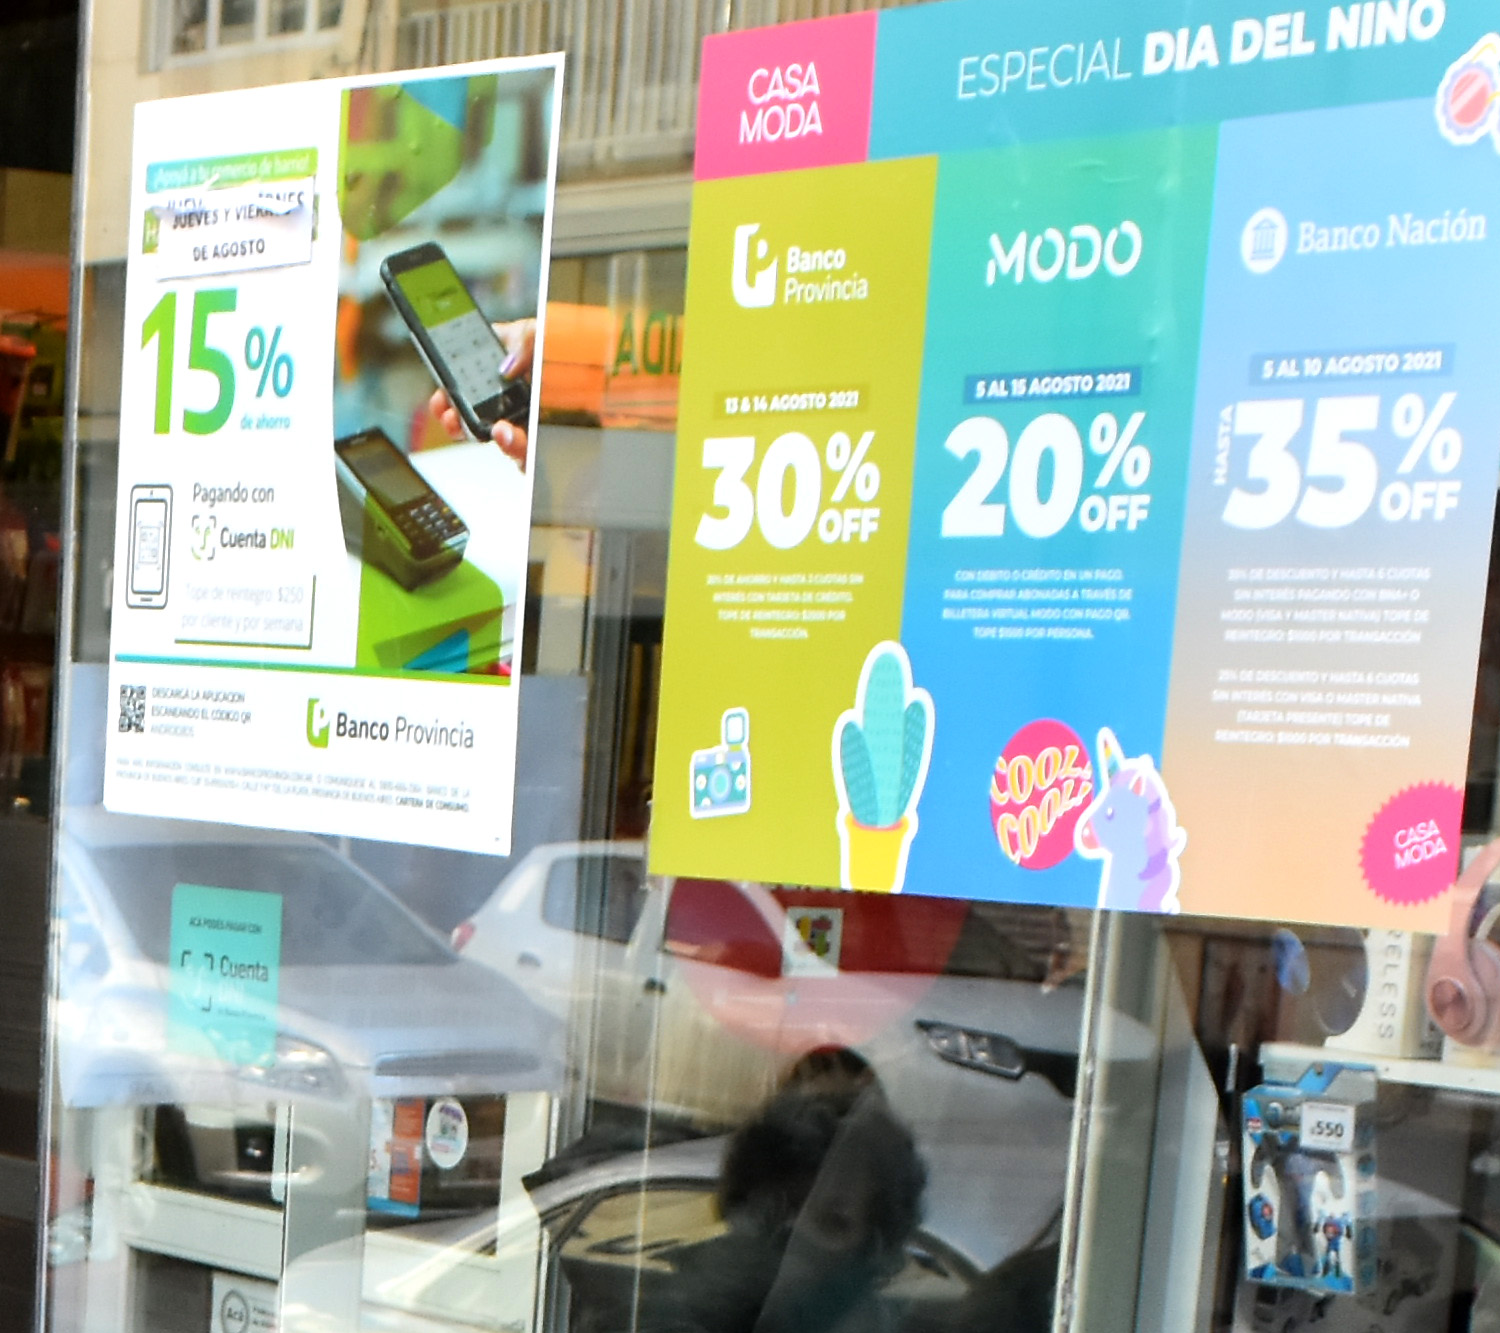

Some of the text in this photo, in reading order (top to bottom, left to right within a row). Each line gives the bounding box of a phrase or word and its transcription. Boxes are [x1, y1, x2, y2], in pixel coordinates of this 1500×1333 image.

[957, 38, 1131, 100] ESPECIAL
[1142, 24, 1219, 76] DIA
[1228, 13, 1316, 65] DEL
[749, 61, 819, 105] CASA
[739, 102, 822, 145] MODA
[223, 206, 231, 222] Y
[1298, 208, 1487, 255] Banco Nación
[193, 238, 265, 262] DE AGOSTO
[786, 247, 846, 273] Banco
[986, 221, 1142, 287] MODO
[784, 273, 868, 304] Provincia
[141, 287, 294, 435] 15%
[1262, 350, 1443, 379] 5 AL 10 AGOSTO 2021
[769, 392, 826, 411] AGOSTO
[829, 390, 859, 409] 2021
[975, 372, 1131, 399] 5 AL 15 AGOSTO 2021
[256, 413, 291, 430] ahorro
[1213, 405, 1235, 487] HASTA
[1221, 391, 1463, 530] 35%
[695, 430, 881, 550] 30%
[941, 410, 1152, 539] 20%
[193, 482, 275, 507] Pagando con
[1379, 481, 1462, 522] OFF
[817, 508, 880, 544] OFF
[1079, 494, 1152, 533] OFF
[220, 527, 295, 550] Cuenta DNI
[335, 711, 475, 749] Banco Provincia
[1393, 819, 1440, 850] CASA
[1394, 840, 1448, 870] MODA
[219, 954, 269, 983] Cuenta
[1310, 1120, 1344, 1138] $550
